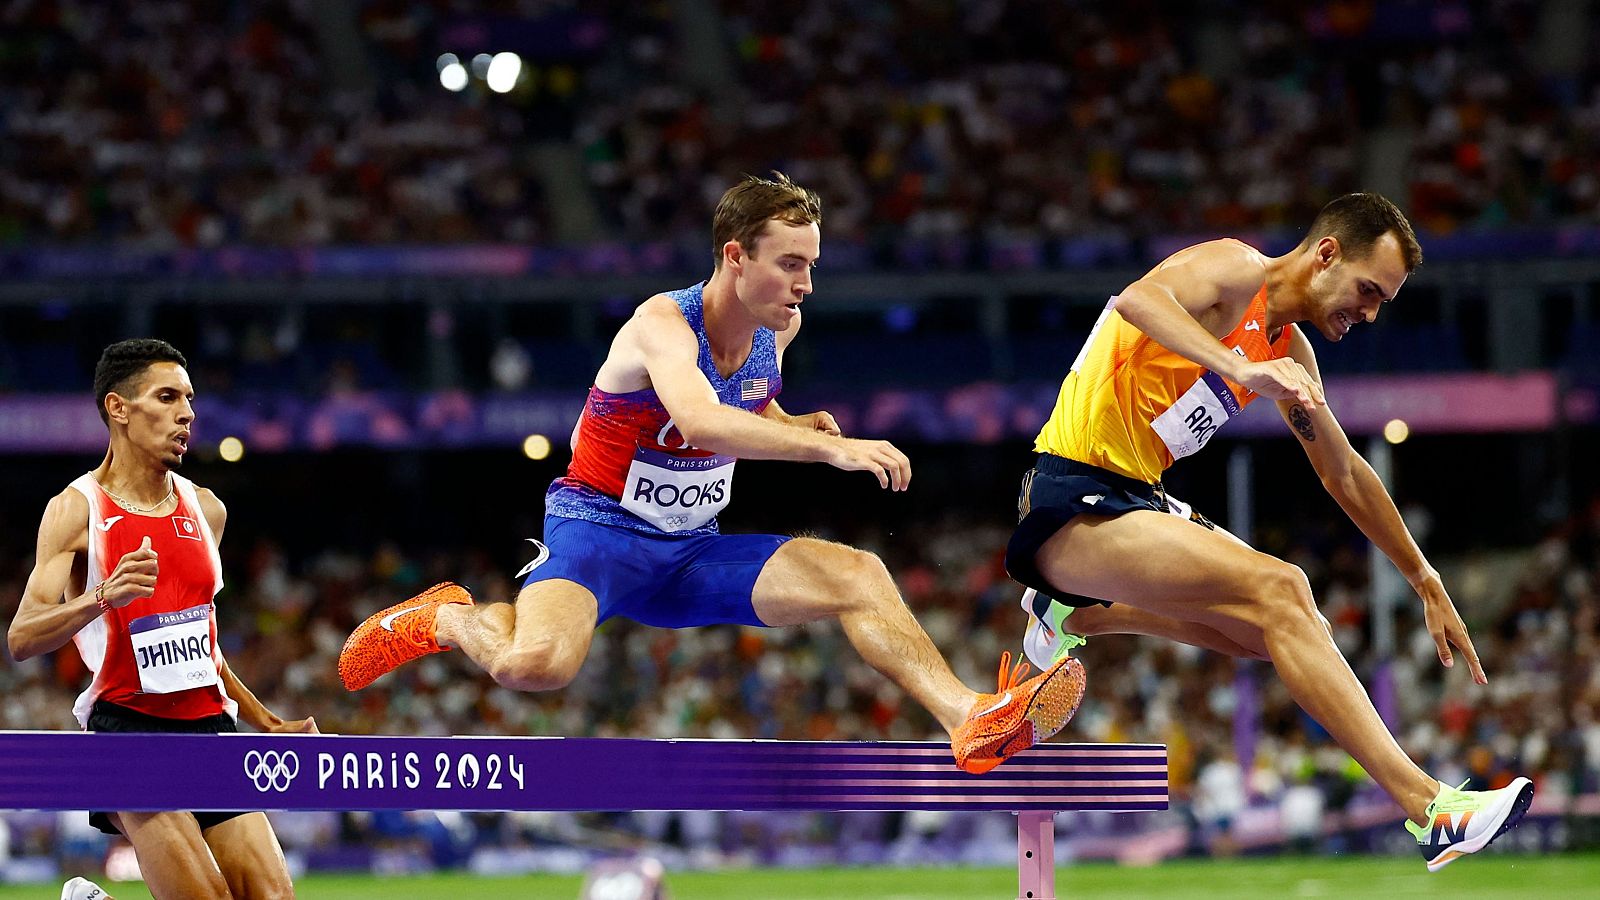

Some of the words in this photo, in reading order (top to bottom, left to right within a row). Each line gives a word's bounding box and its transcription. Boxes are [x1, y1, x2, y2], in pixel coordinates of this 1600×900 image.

[1184, 405, 1217, 446] ARC
[667, 458, 695, 468] PARIS
[633, 476, 725, 508] ROOKS
[159, 613, 185, 625] PARIS
[318, 751, 420, 789] PARIS
[435, 752, 524, 789] 2024
